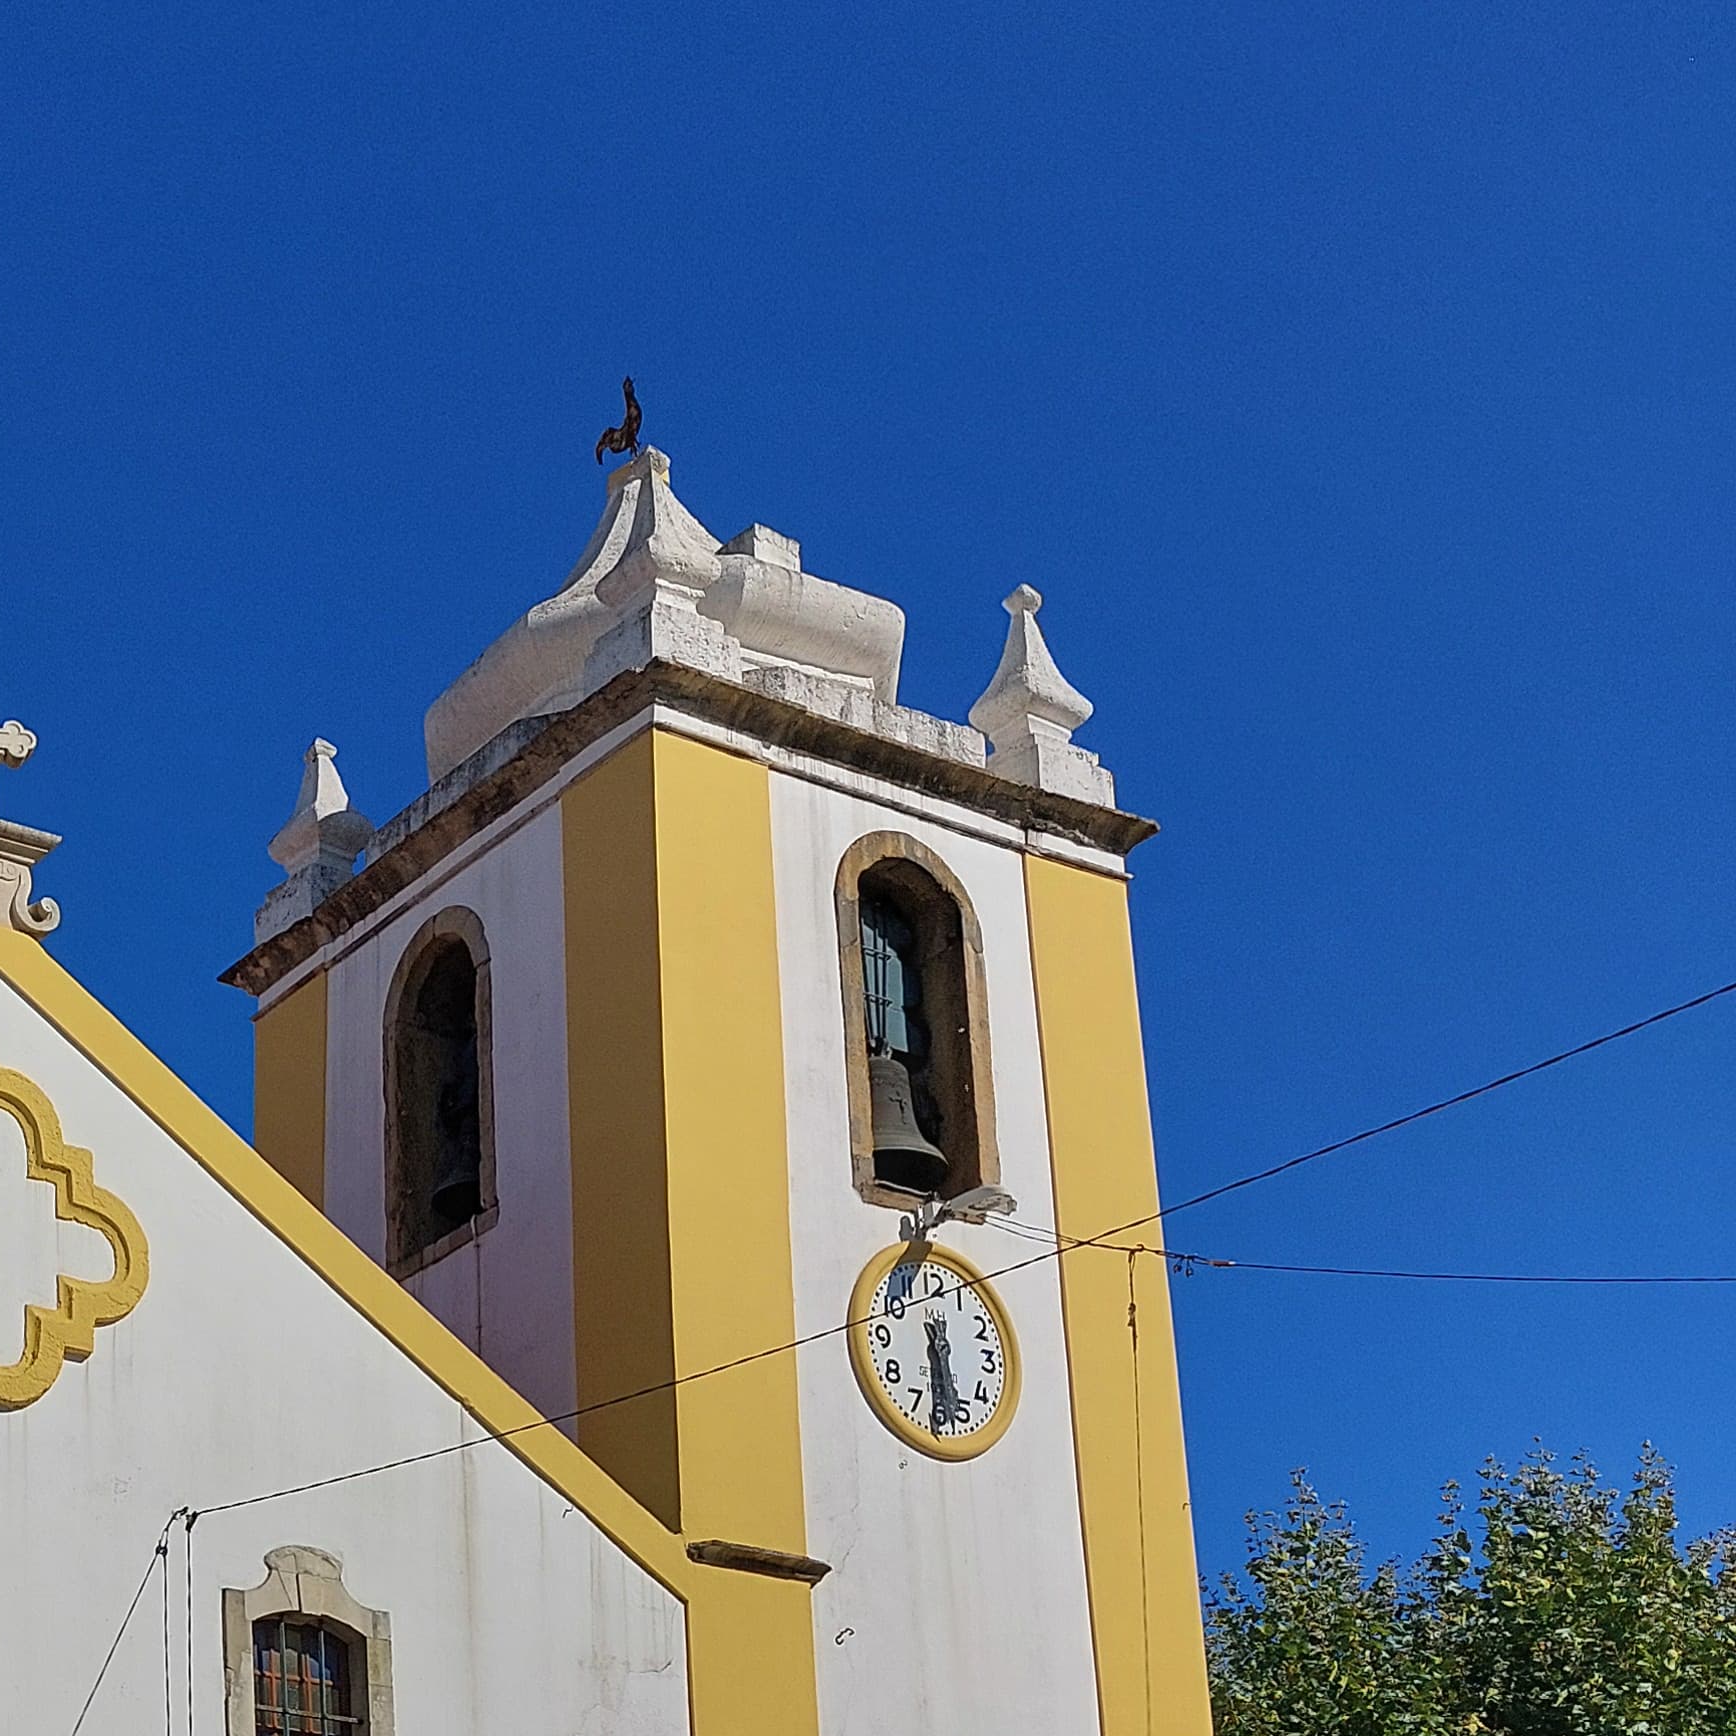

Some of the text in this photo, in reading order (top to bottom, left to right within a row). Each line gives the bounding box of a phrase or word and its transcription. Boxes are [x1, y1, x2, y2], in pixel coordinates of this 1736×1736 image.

[901, 1275, 913, 1299] 11
[923, 1271, 945, 1299] 12
[884, 1295, 905, 1320] 10
[956, 1287, 962, 1312] 1
[875, 1324, 891, 1349] 9
[973, 1315, 989, 1342] 2
[885, 1359, 901, 1384] 8
[980, 1348, 996, 1374] 3
[907, 1387, 923, 1413] 7
[973, 1380, 989, 1405] 4
[954, 1399, 971, 1424] 5
